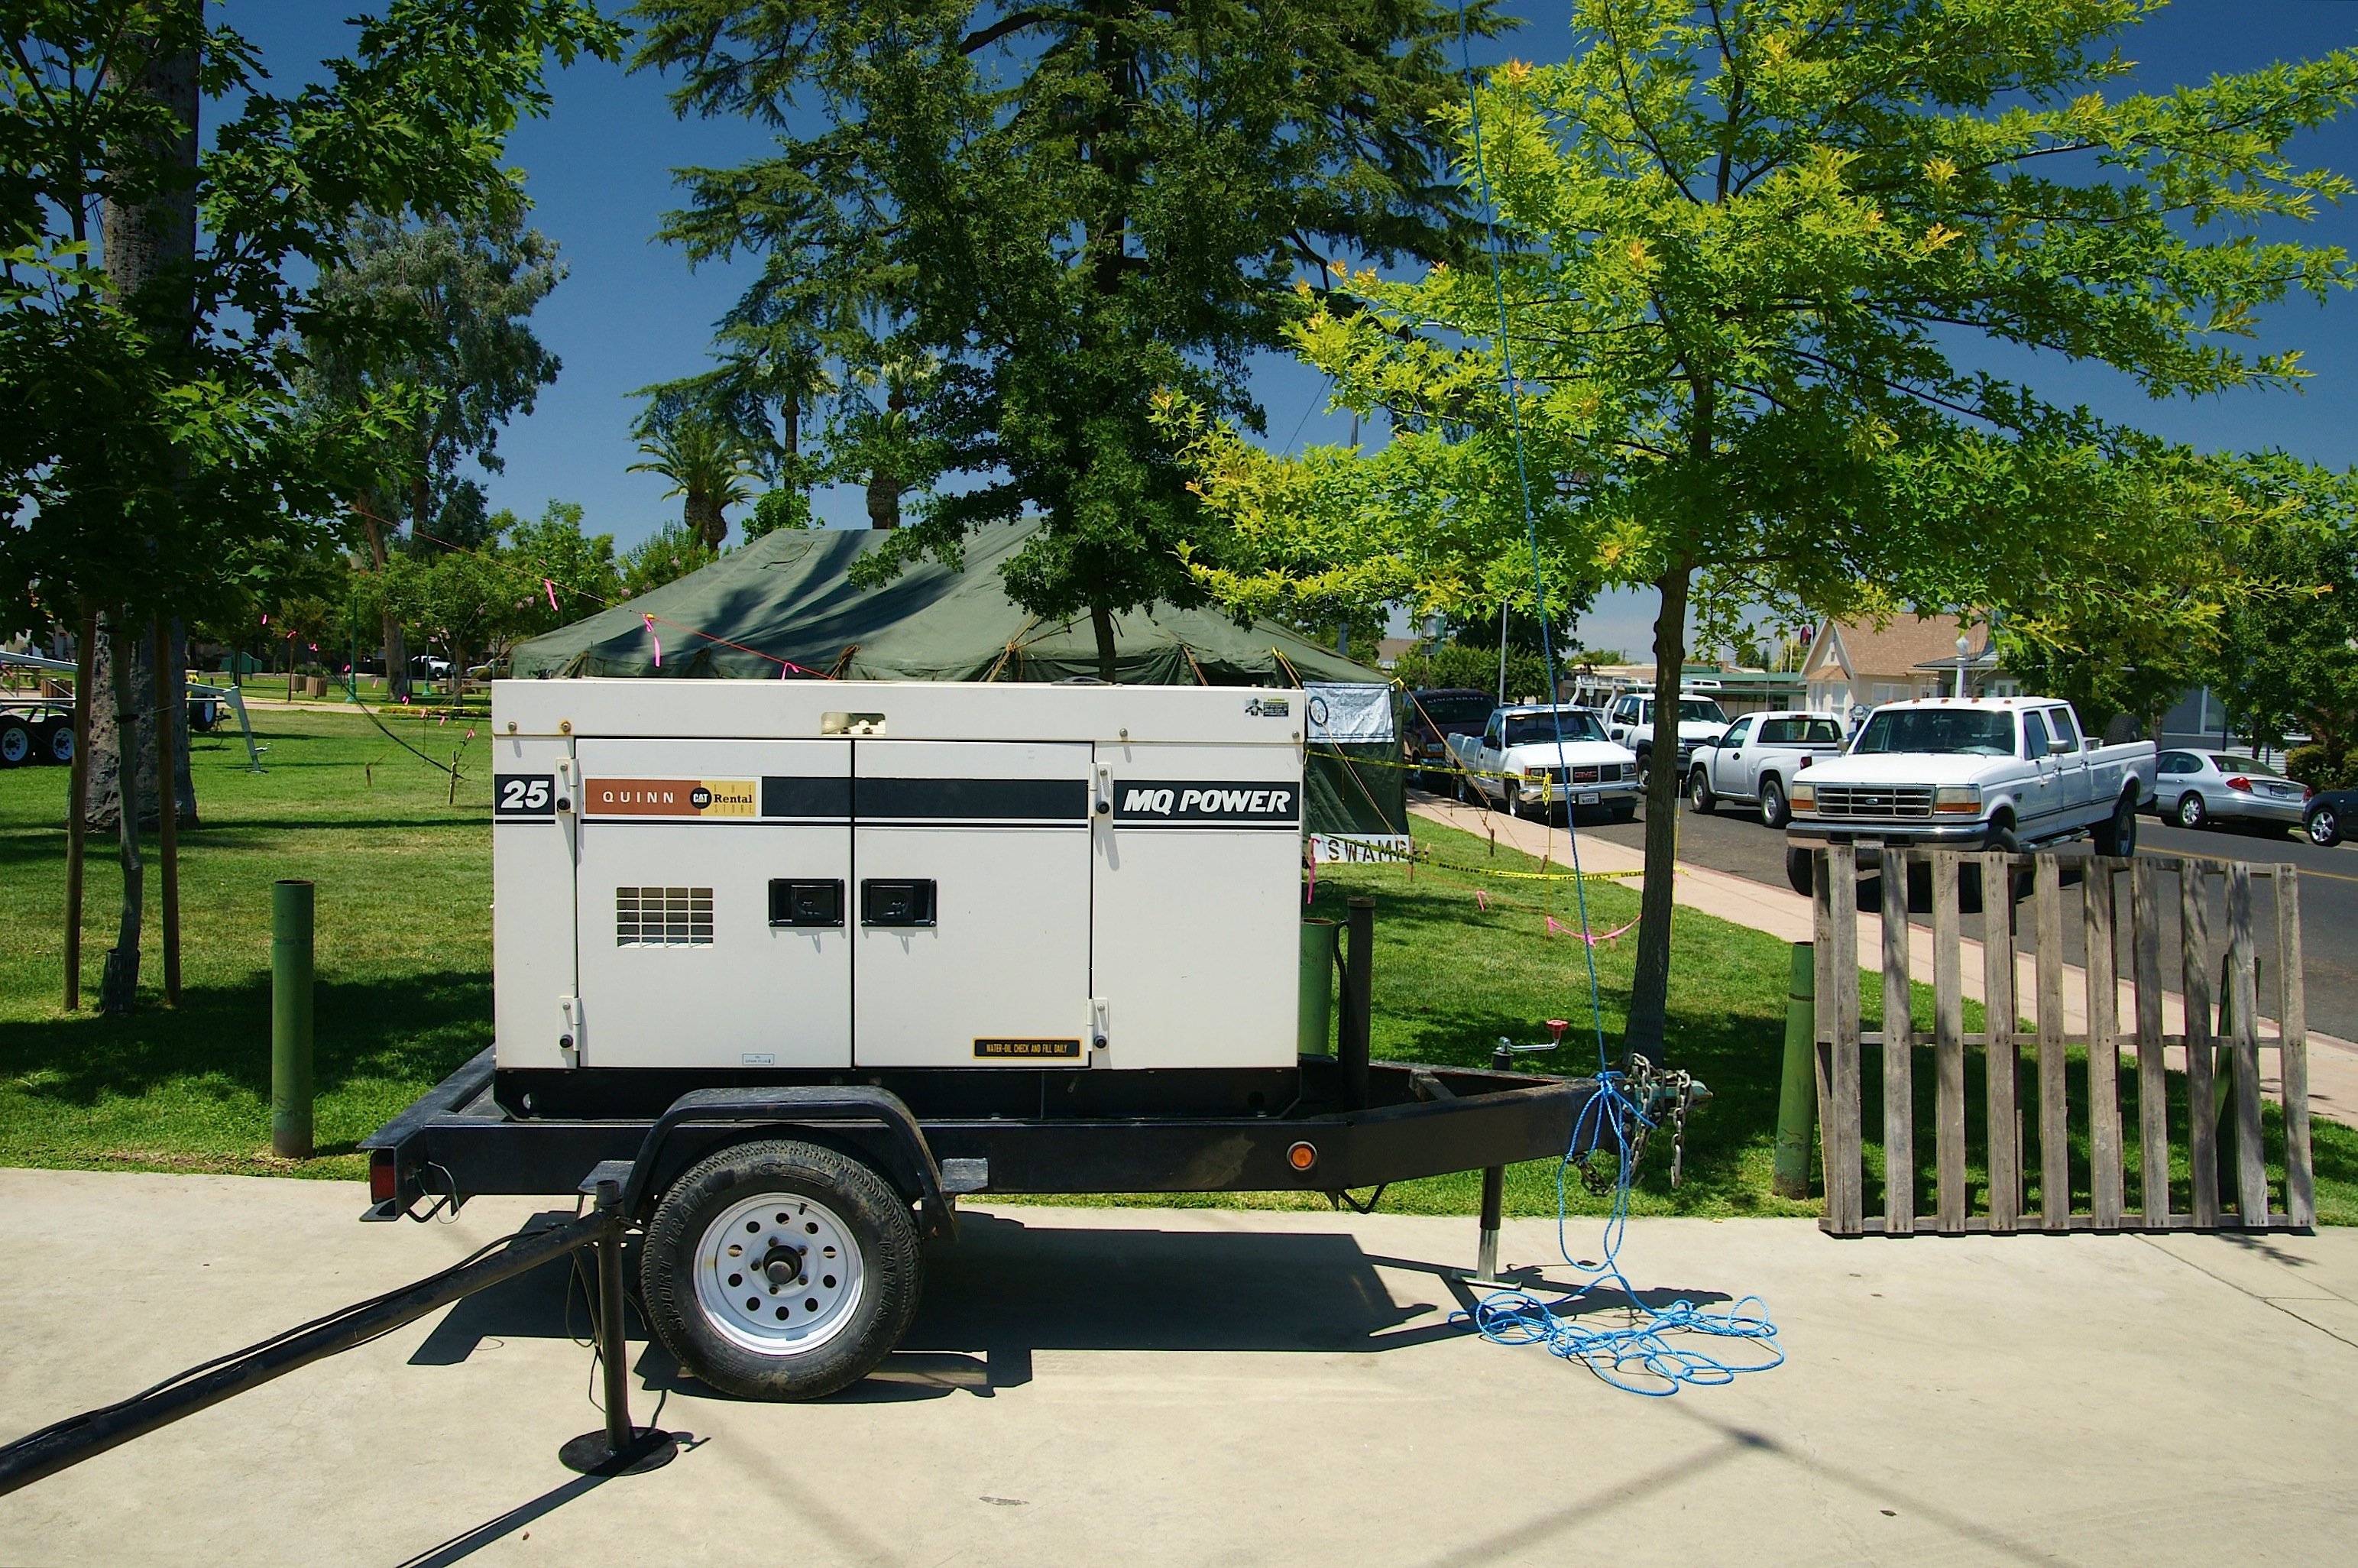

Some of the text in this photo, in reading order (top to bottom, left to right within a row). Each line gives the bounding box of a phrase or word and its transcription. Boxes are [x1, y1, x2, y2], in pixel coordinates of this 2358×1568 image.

[500, 780, 549, 808] 25
[602, 791, 674, 803] QUINN
[693, 793, 708, 803] CAT
[714, 794, 753, 803] Rental
[1123, 789, 1291, 815] MQ POWER
[986, 1043, 1068, 1053] WATER-OIL CHECK AND FILL DAILY
[659, 1186, 714, 1330] SPORT TRAIL
[859, 1240, 897, 1344] CARLISLE
